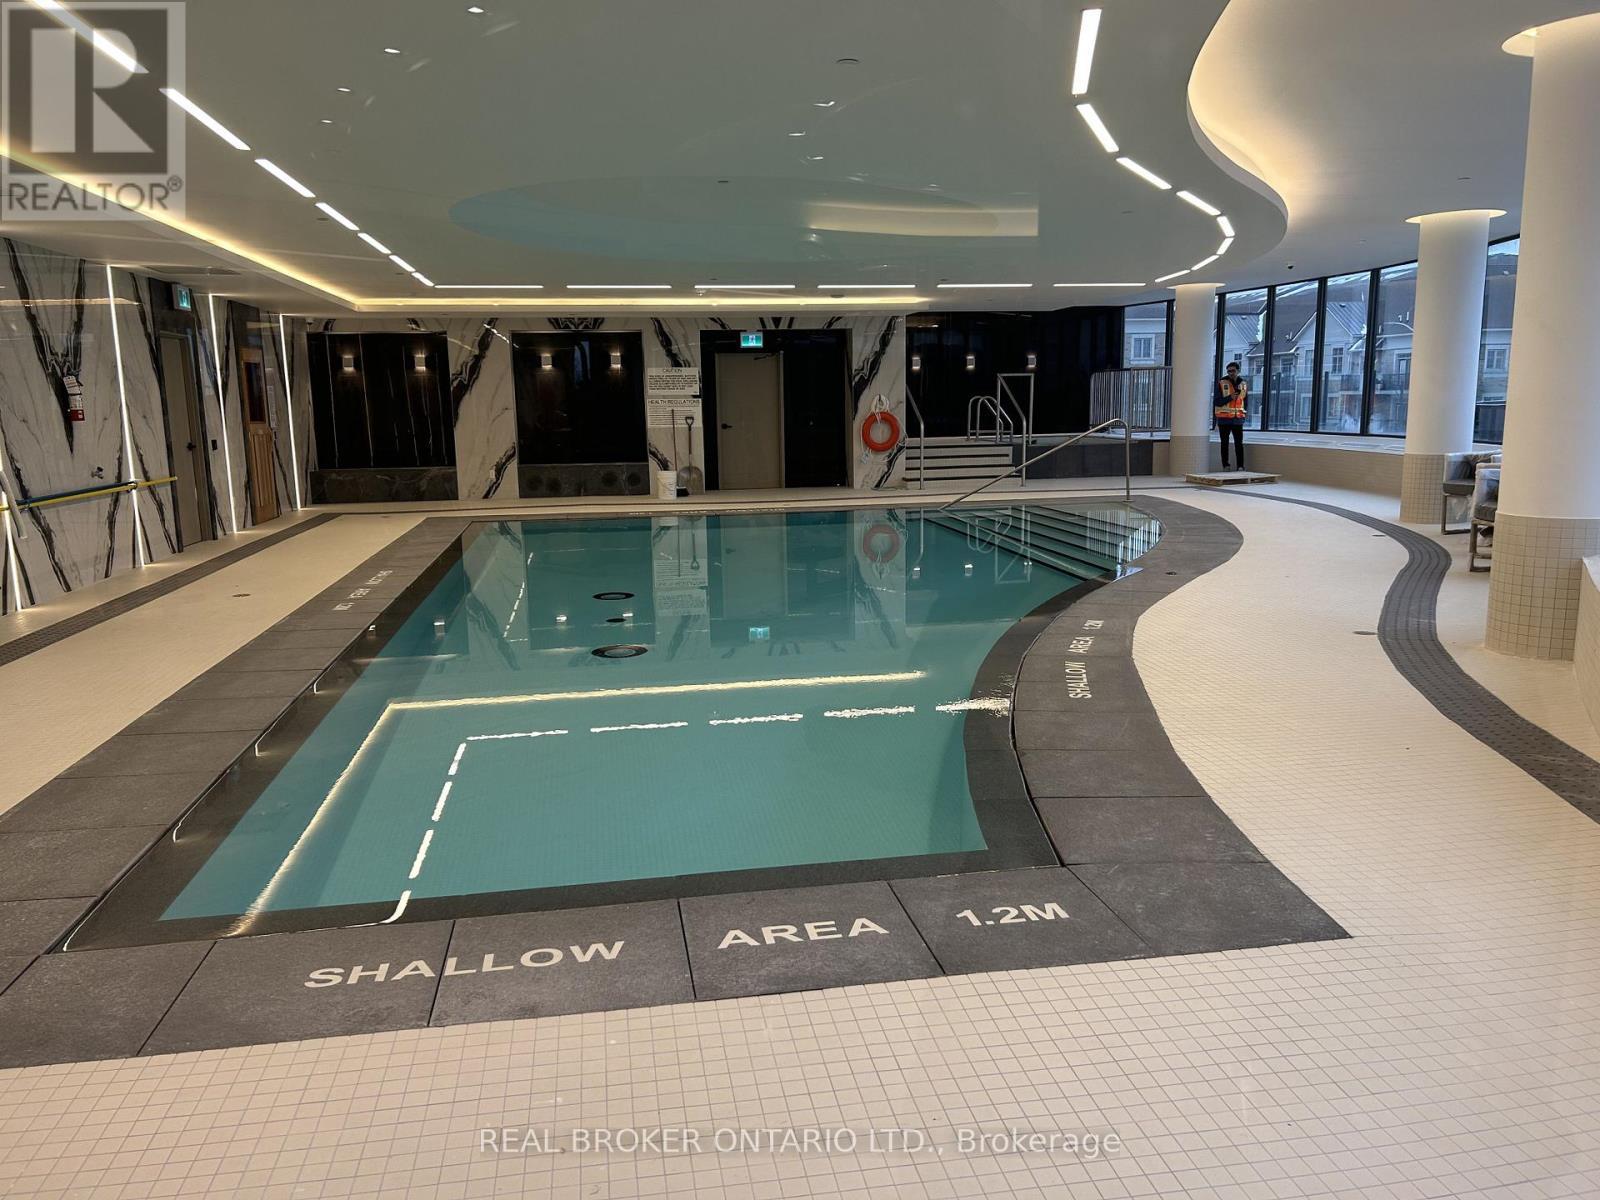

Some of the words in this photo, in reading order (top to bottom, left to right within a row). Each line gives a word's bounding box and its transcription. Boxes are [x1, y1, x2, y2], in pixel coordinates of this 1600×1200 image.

[1067, 636, 1095, 654] AREA
[1064, 661, 1092, 699] SHALLOW
[303, 940, 625, 989] SHALLOW
[717, 917, 890, 949] AREA
[956, 902, 1071, 926] 1.2M
